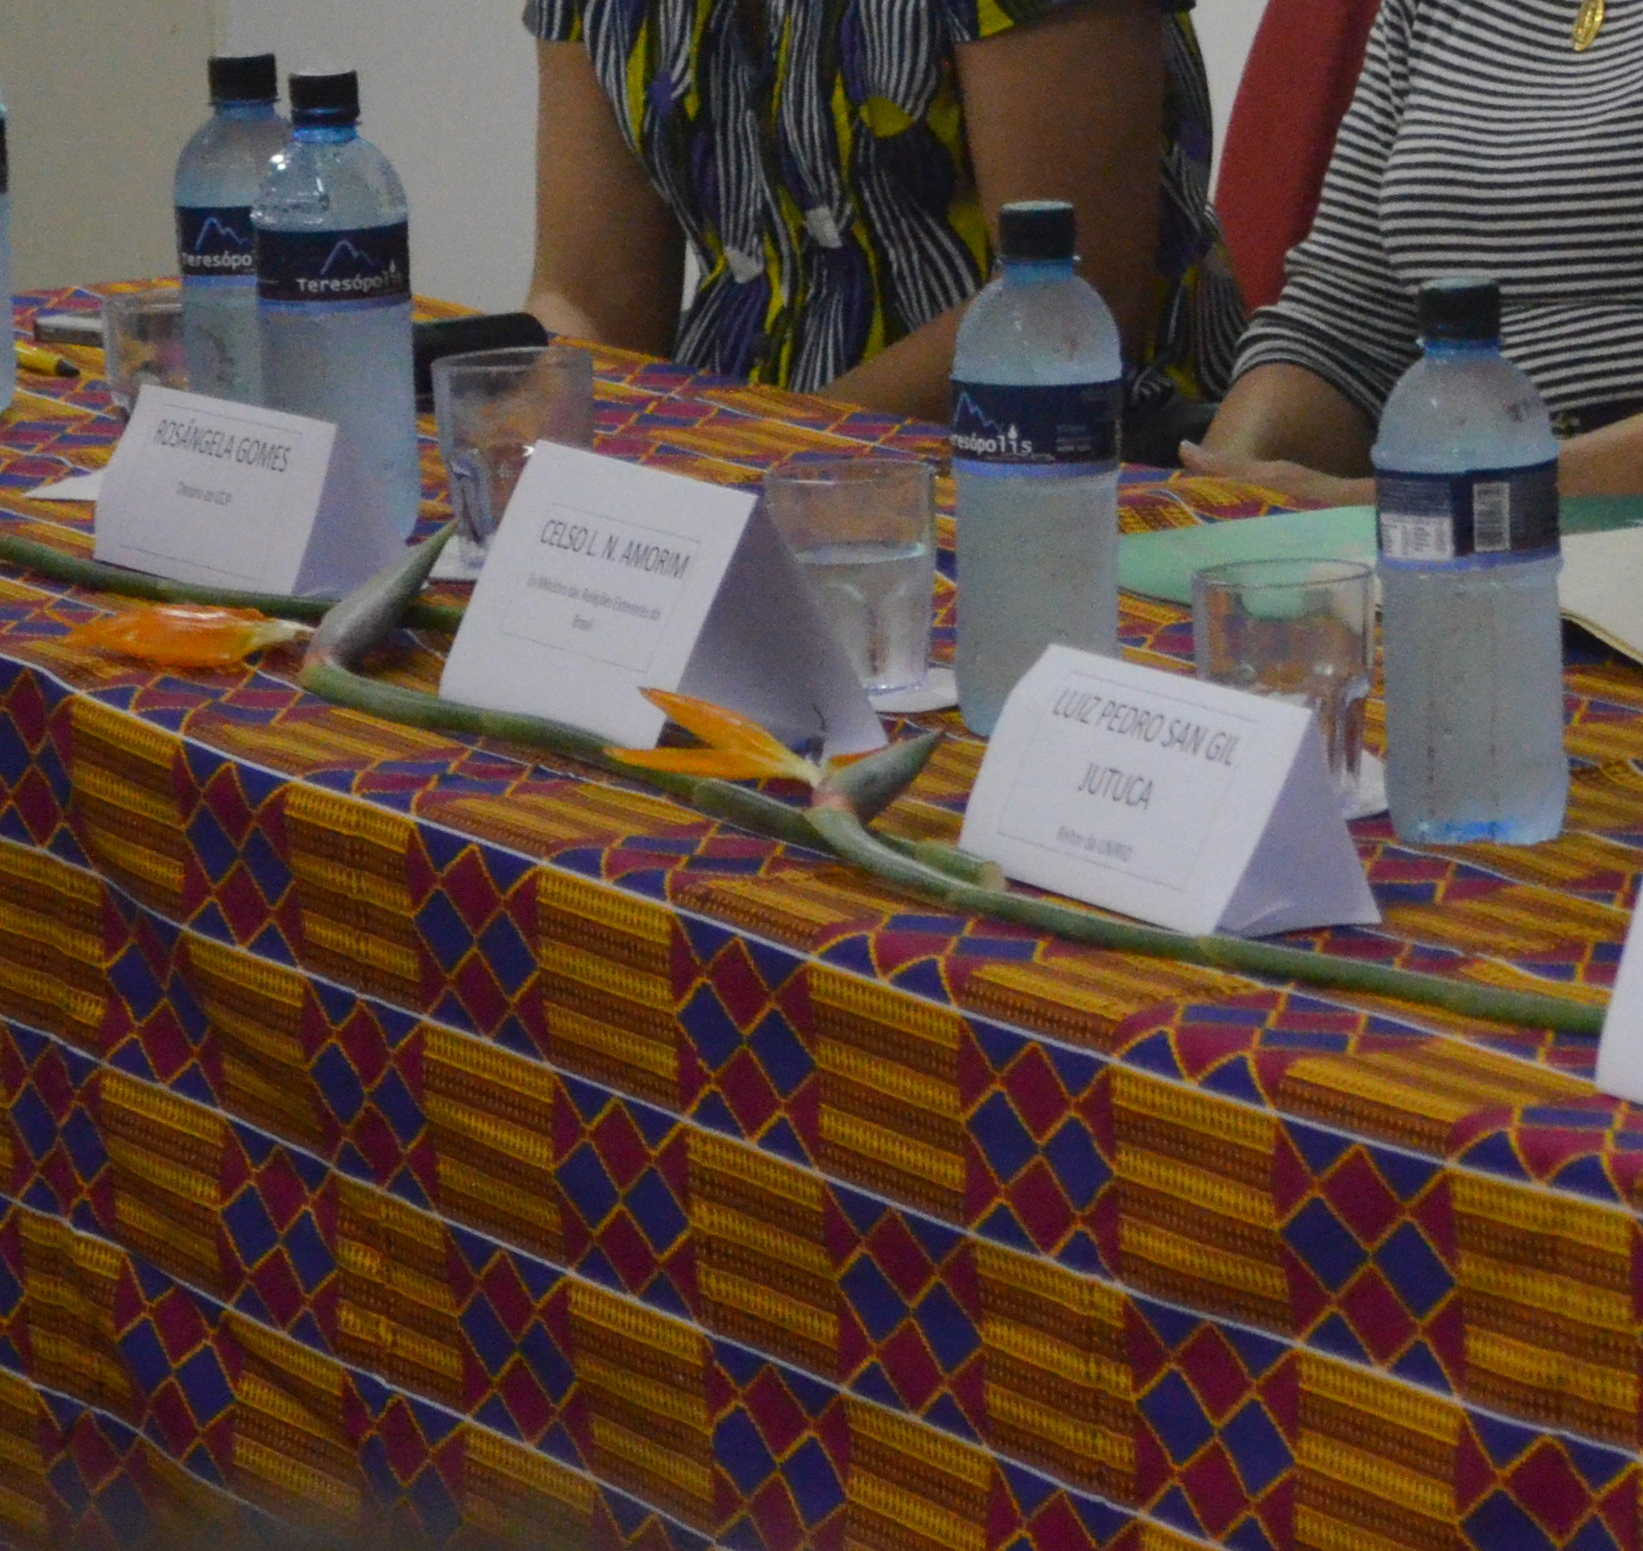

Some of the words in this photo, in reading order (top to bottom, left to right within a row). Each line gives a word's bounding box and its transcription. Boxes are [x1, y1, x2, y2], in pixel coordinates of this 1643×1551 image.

[182, 250, 252, 269] Teresópo
[153, 418, 235, 459] ROSÂNGELA
[235, 437, 292, 473] GOMES
[540, 518, 588, 553] CELSO
[600, 534, 619, 562] N.
[618, 540, 691, 580] AMORIM
[1053, 688, 1102, 724] LUIZ
[1096, 699, 1165, 743] PEDRO
[1161, 718, 1209, 756] SAN
[1205, 731, 1241, 766] GIL
[1078, 762, 1154, 811] JUTUCA
